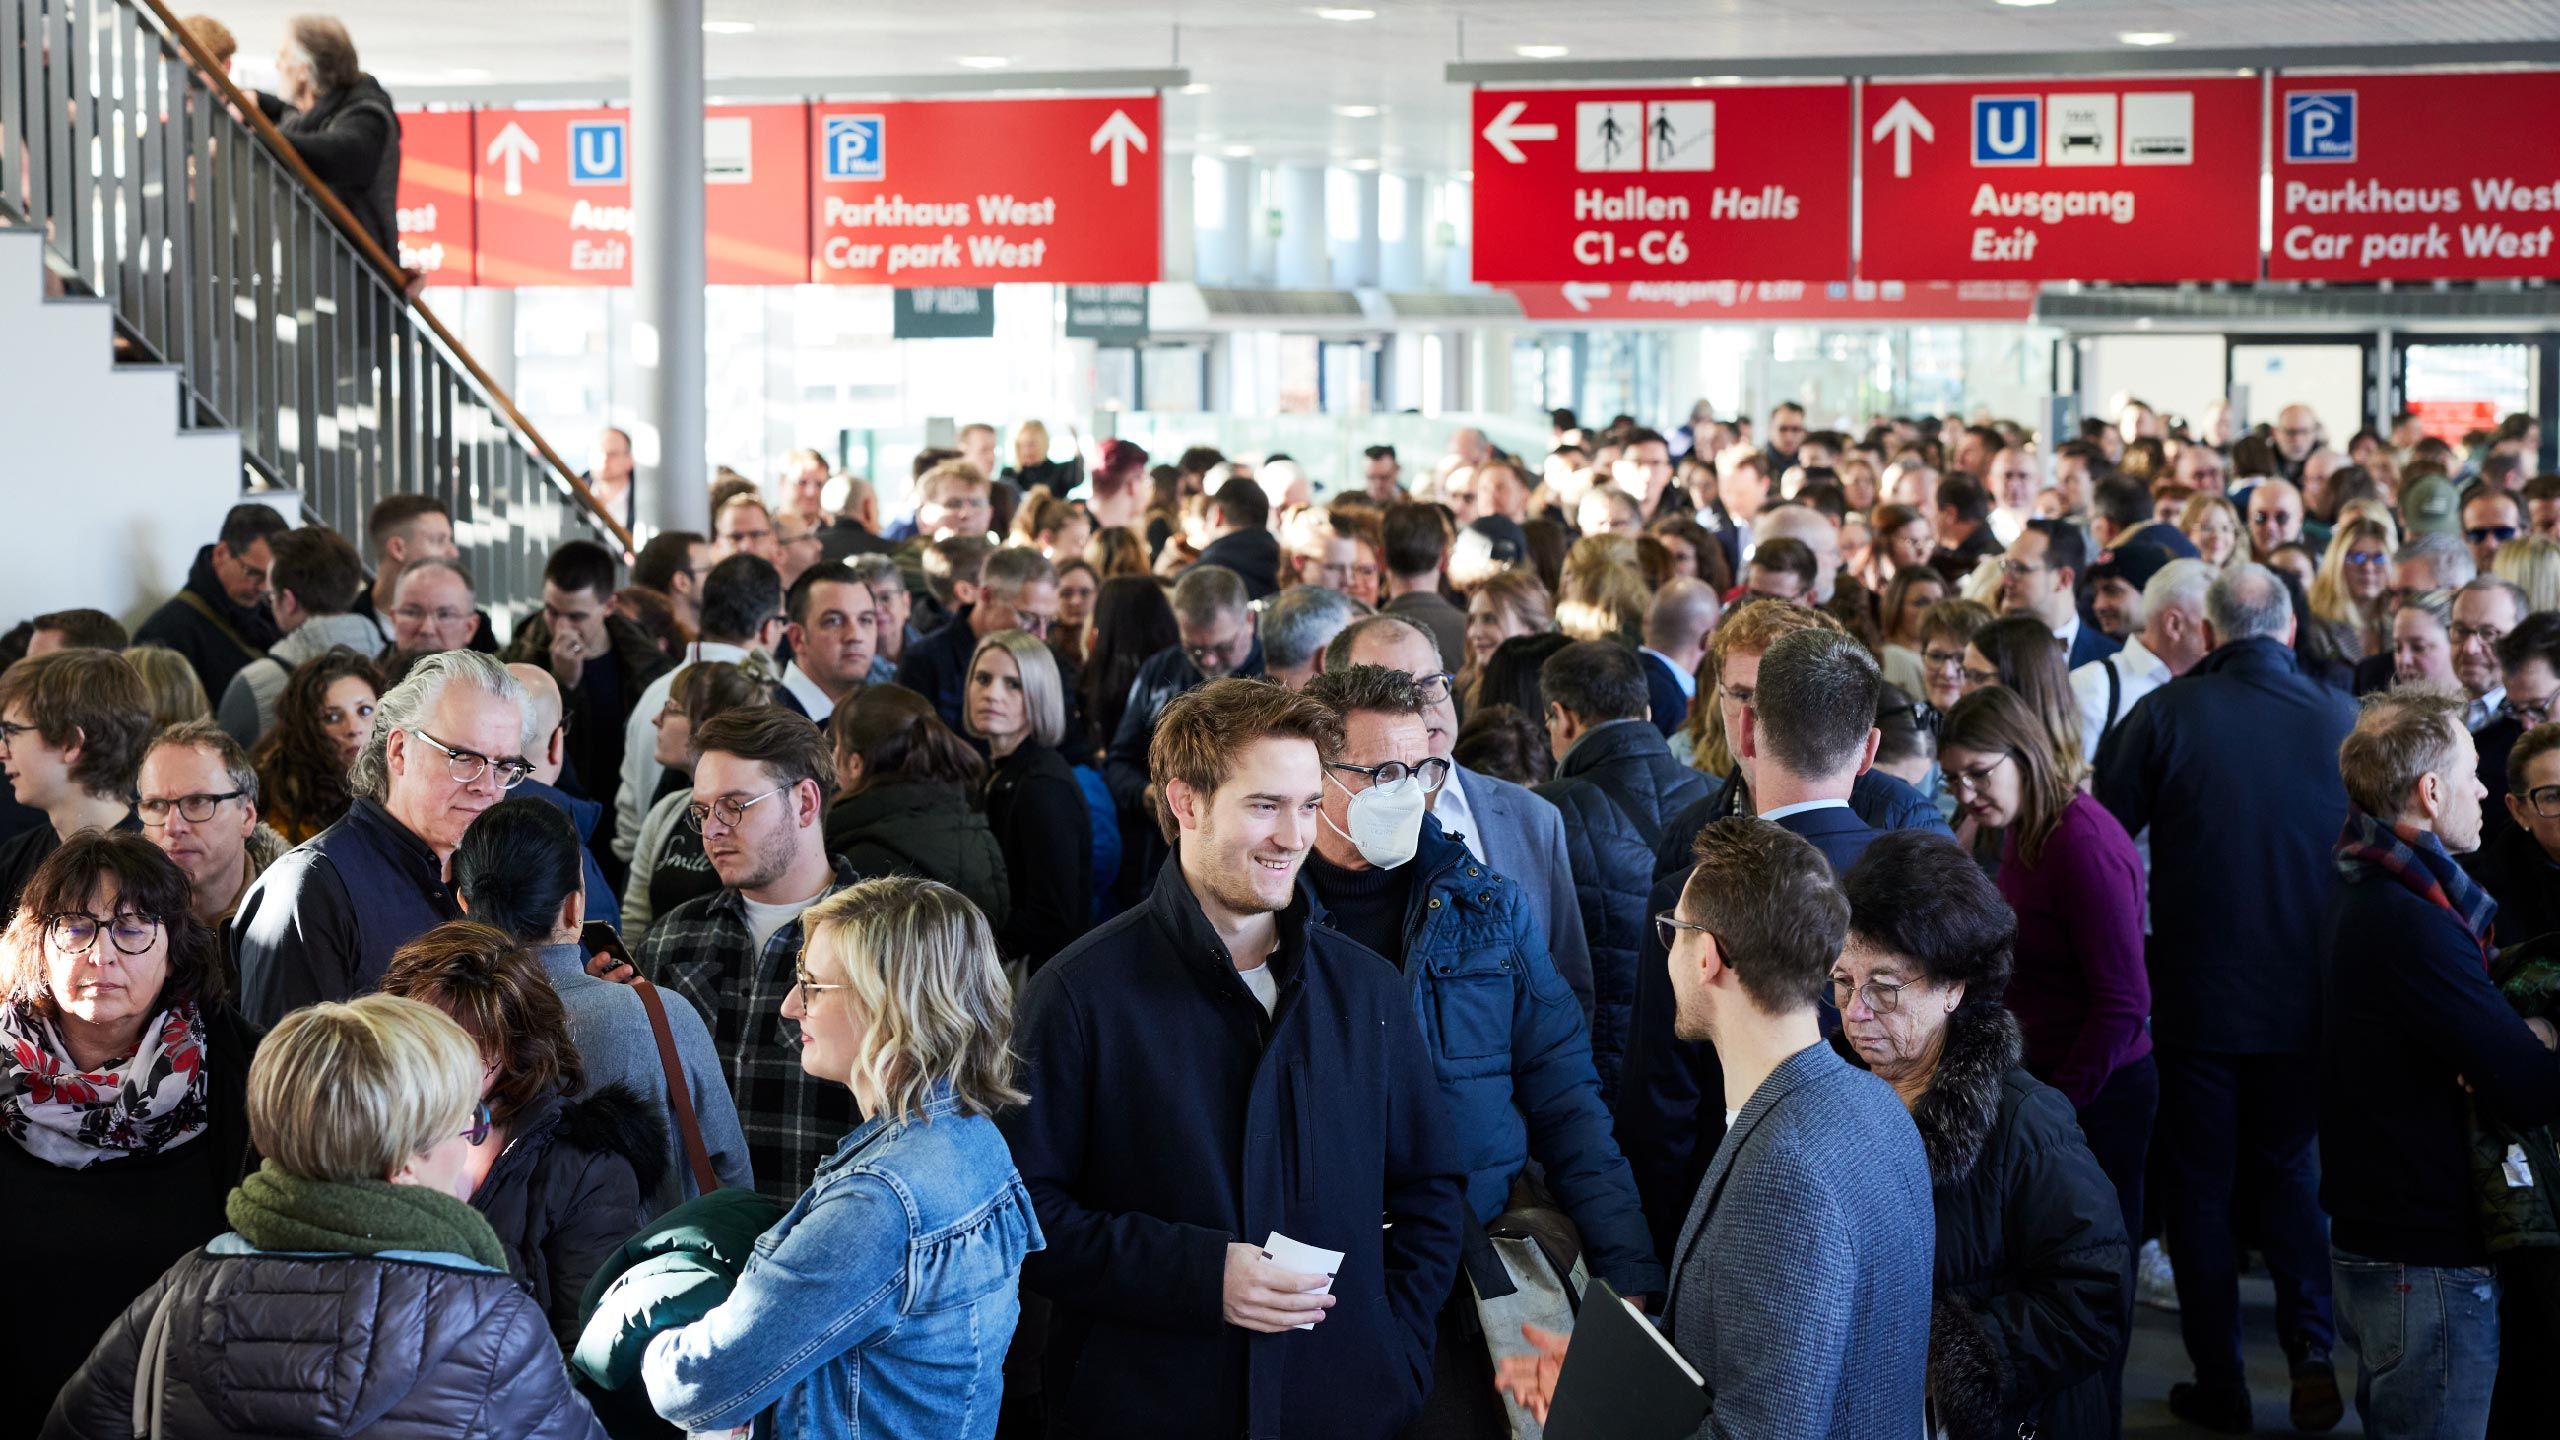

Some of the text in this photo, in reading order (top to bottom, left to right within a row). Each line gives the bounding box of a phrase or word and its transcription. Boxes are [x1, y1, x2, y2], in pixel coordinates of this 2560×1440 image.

[1988, 108, 2026, 154] U
[2303, 110, 2334, 154] P
[580, 130, 617, 175] U
[824, 193, 1056, 227] Parkhaus West
[1574, 185, 1800, 221] Hallen Halls
[1970, 184, 2135, 224] Ausgang
[2285, 178, 2560, 214] Parkhaus West
[396, 203, 437, 233] est
[570, 238, 626, 271] Exit
[824, 235, 1047, 275] Car park West
[1970, 226, 2039, 262] Exit
[2283, 222, 2554, 268] Car park West
